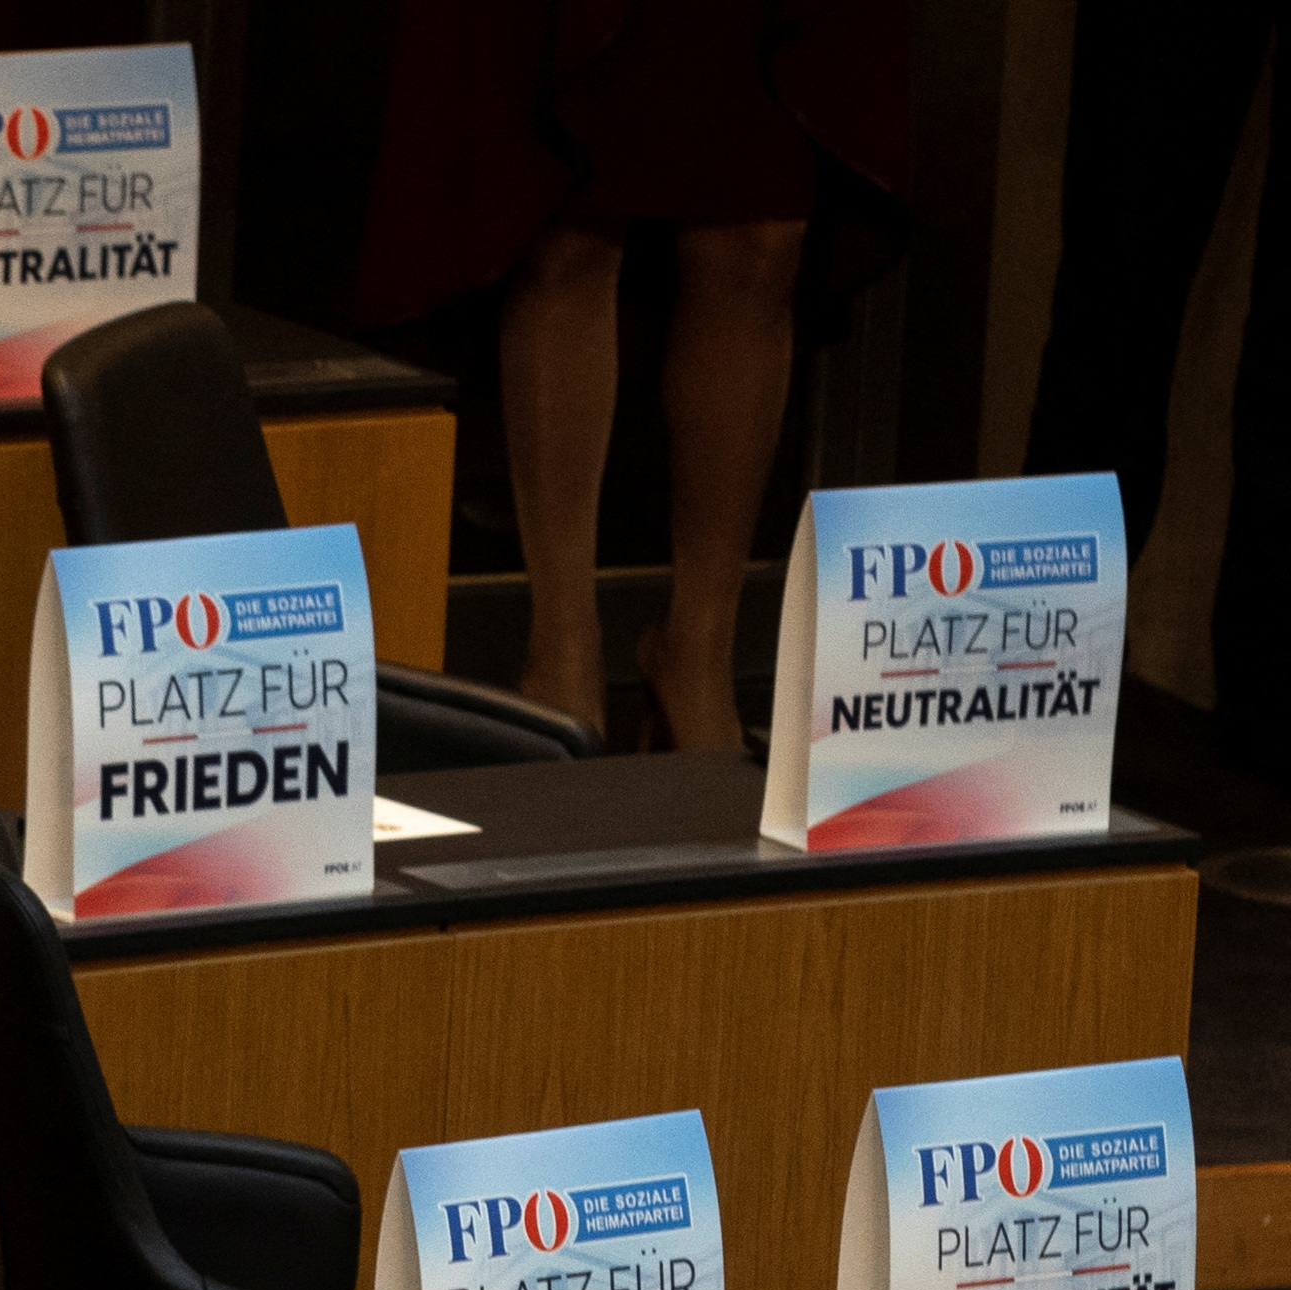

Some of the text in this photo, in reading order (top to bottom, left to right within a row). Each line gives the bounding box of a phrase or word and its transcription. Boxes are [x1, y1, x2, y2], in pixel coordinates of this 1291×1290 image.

[81, 165, 154, 213] FÜR
[865, 601, 1079, 660] PLATZ FÜR
[99, 649, 349, 729] PLATZ FÜR
[831, 671, 1100, 732] NEUTRALITÄT
[100, 740, 348, 821] FRIEDEN
[1059, 1135, 1159, 1161] DIE SOZIALE
[1060, 1154, 1160, 1179] HEIMATPARTEI
[583, 1187, 682, 1213] DIE SOZIALE
[586, 1206, 684, 1232] HEIMATPARTEI
[938, 1198, 1150, 1271] PLATZ FÜR
